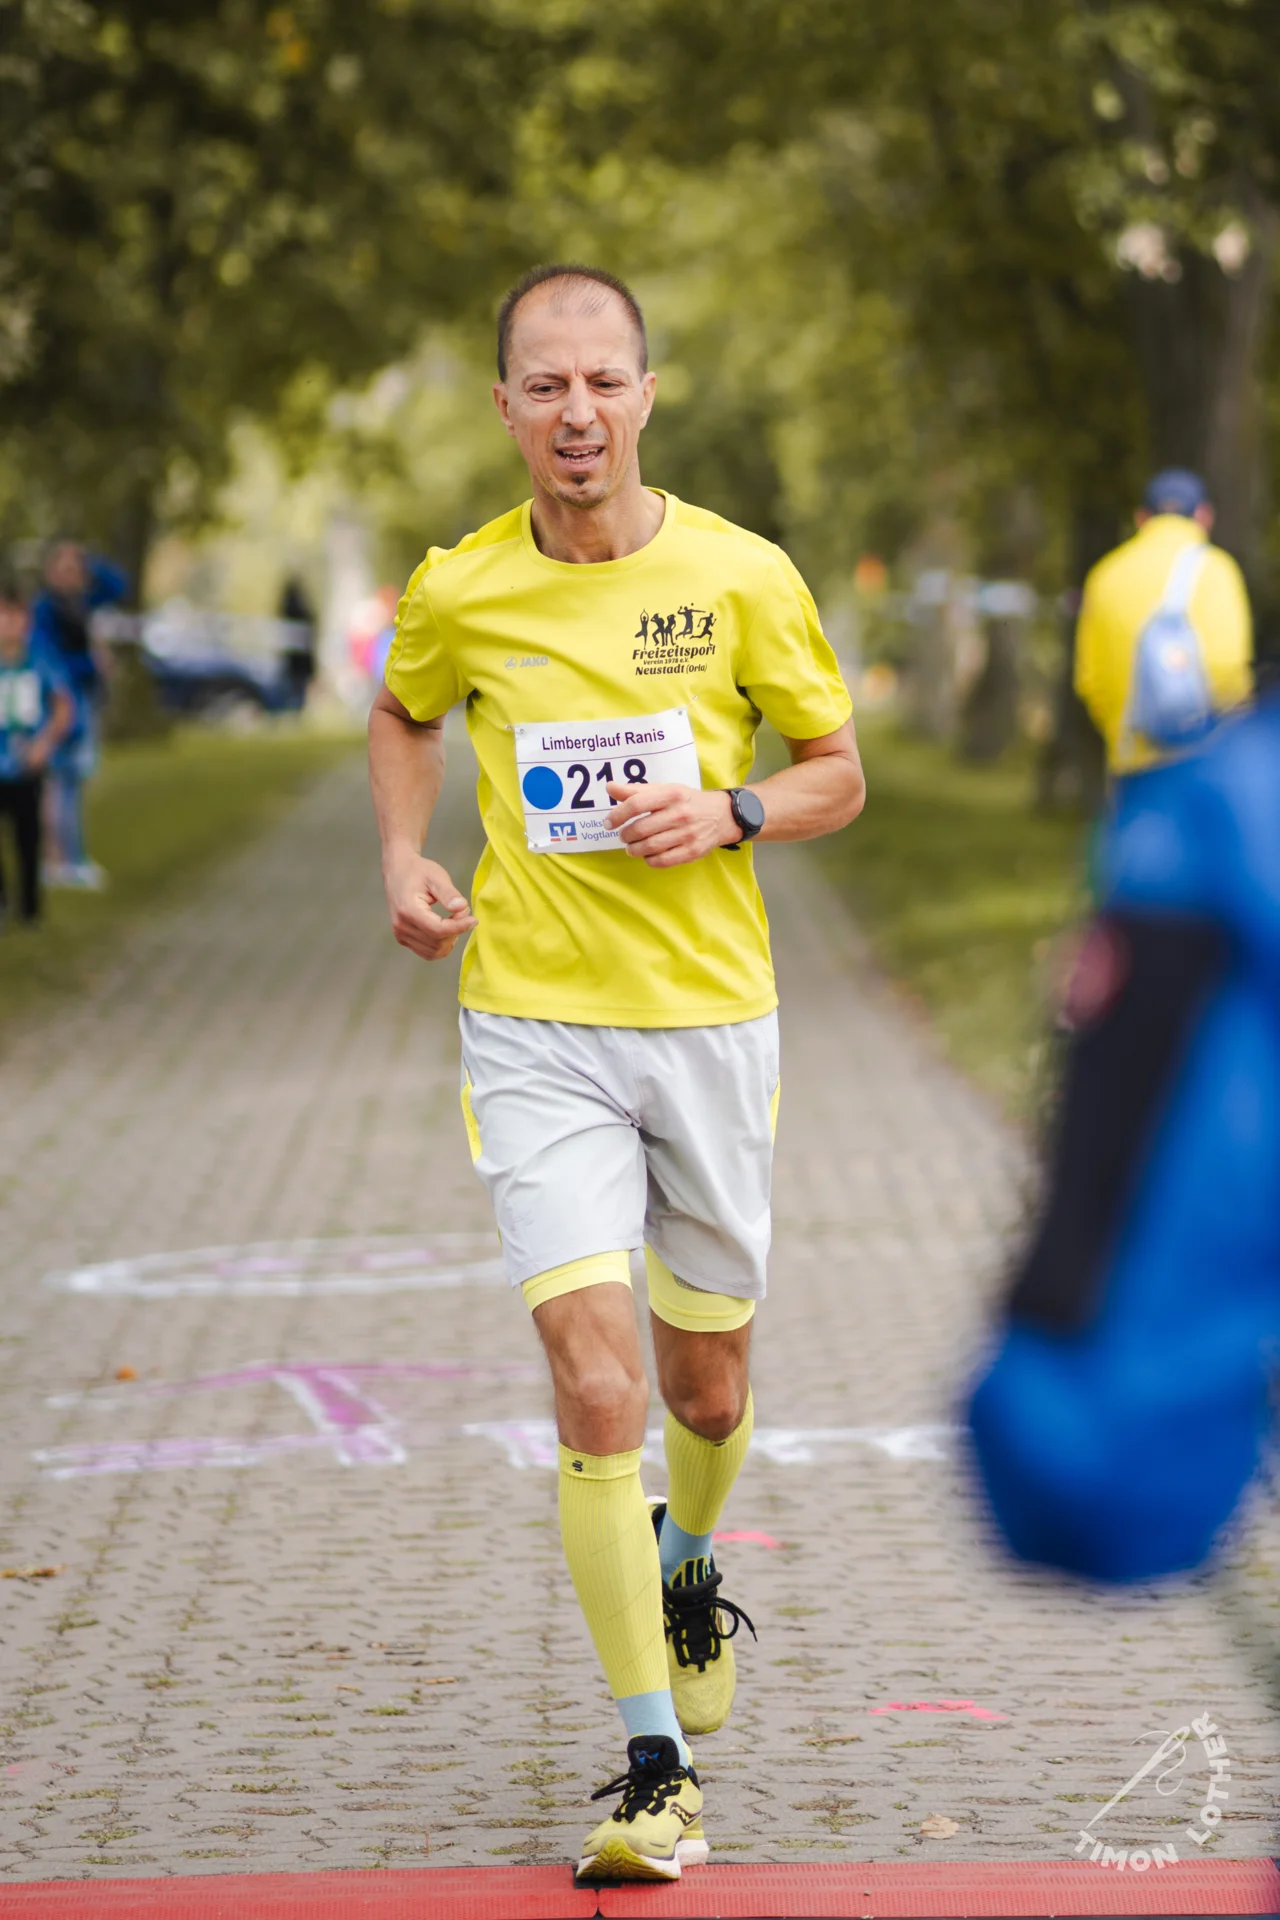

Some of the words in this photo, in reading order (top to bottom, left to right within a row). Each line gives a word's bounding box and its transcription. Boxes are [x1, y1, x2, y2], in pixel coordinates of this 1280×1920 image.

[632, 645, 716, 660] Freizeitsport
[519, 656, 549, 667] JAKO
[635, 664, 685, 676] Neustadt
[686, 663, 708, 674] (Orla)
[542, 732, 621, 752] Limberglauf
[625, 728, 665, 745] Ranis
[579, 819, 605, 829] Volks
